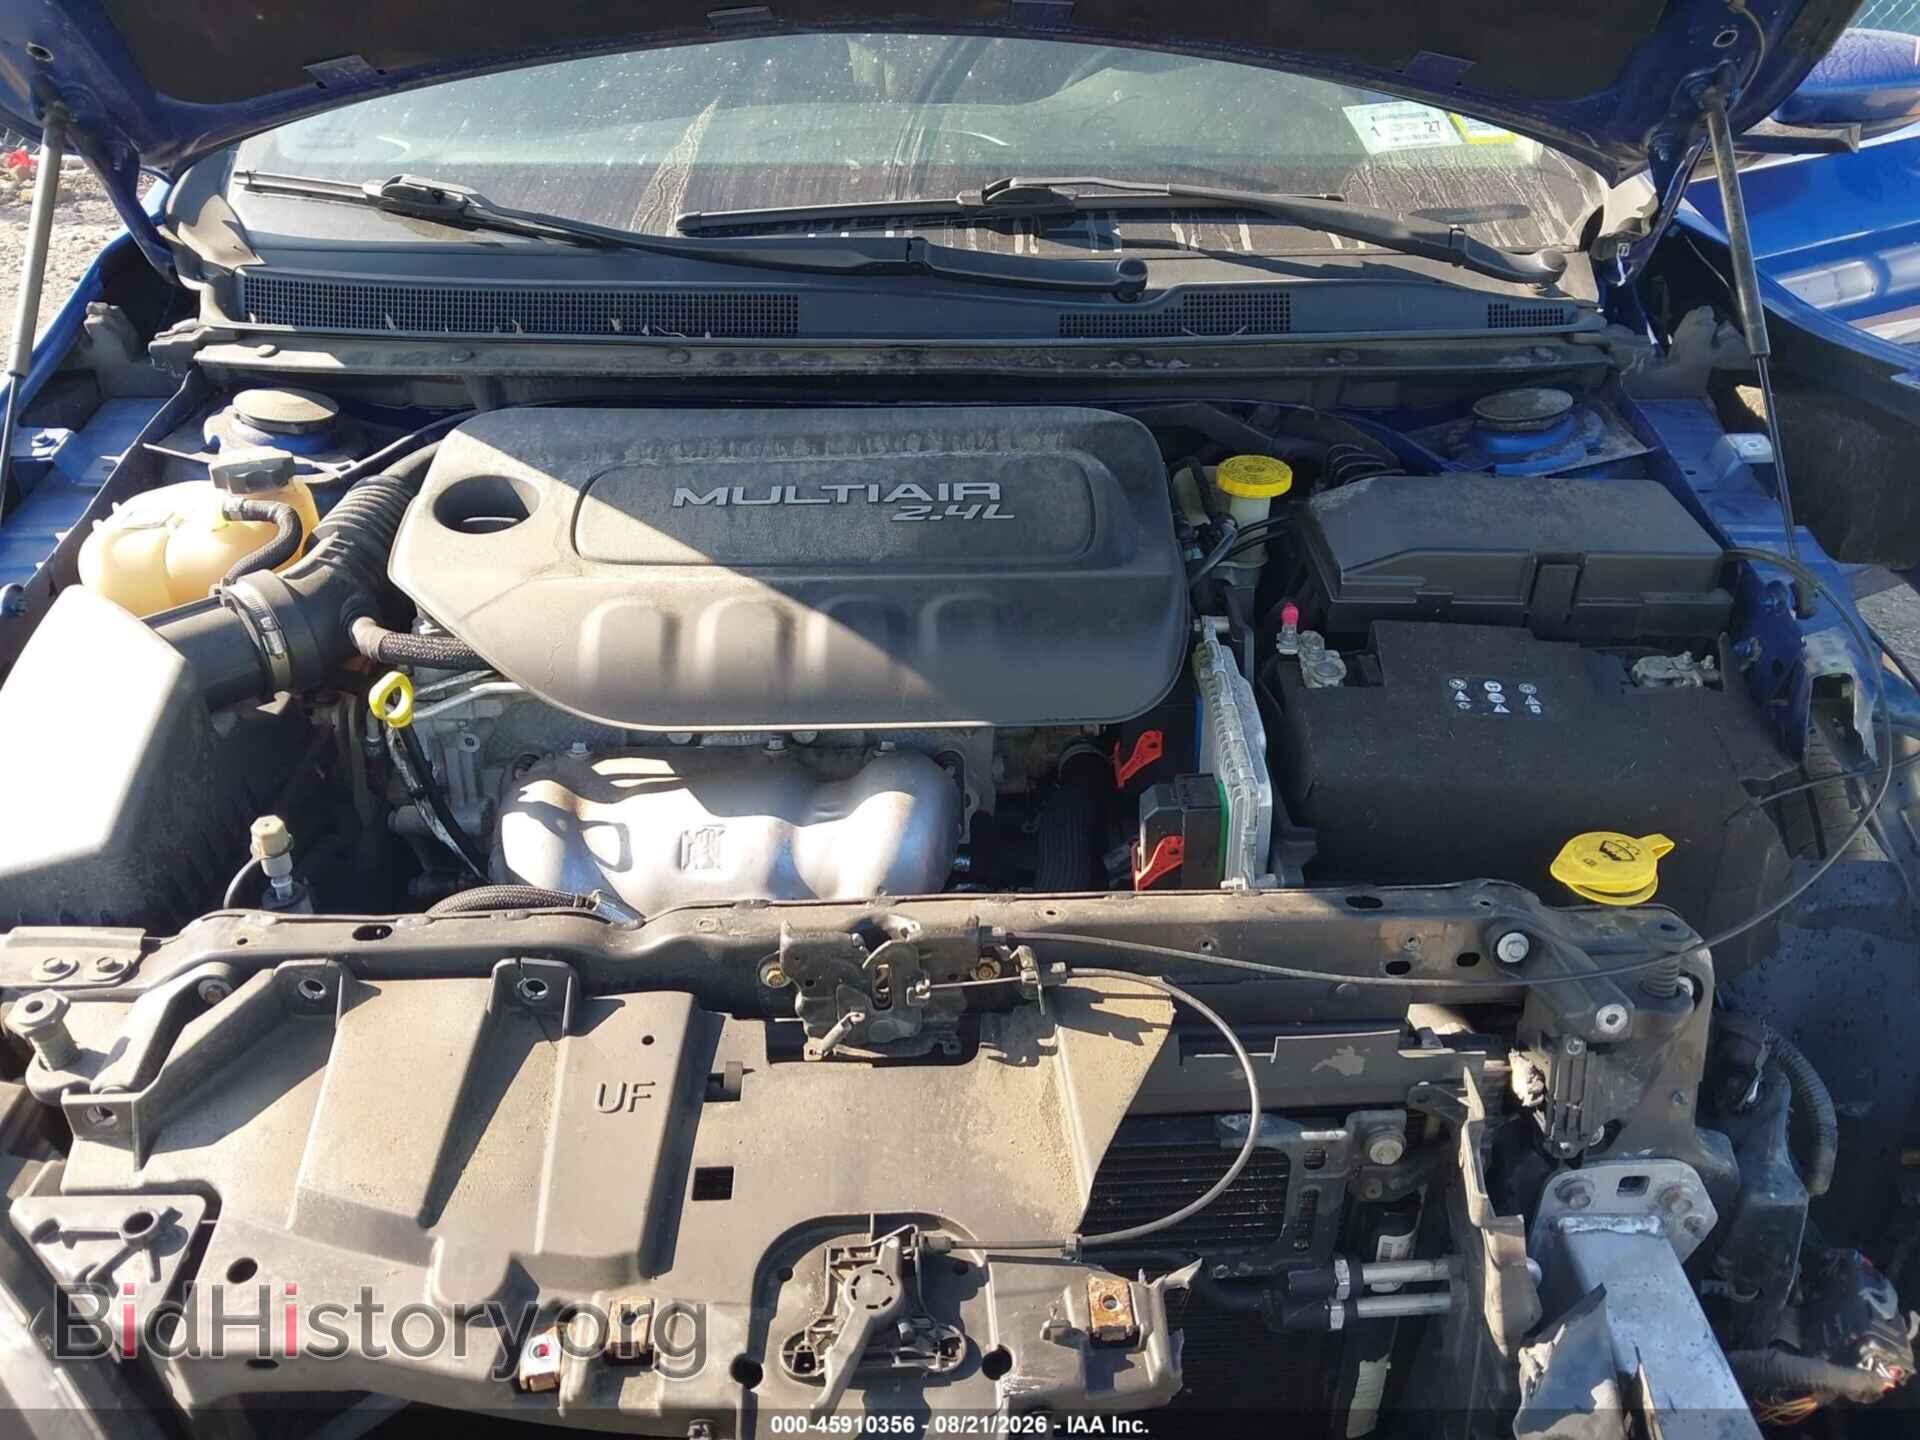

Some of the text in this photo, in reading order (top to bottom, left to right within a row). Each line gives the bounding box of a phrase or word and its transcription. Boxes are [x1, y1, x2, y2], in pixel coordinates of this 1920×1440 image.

[672, 481, 1001, 508] MULTIAIR
[891, 503, 1016, 521] 2.4L
[594, 1081, 656, 1115] UF
